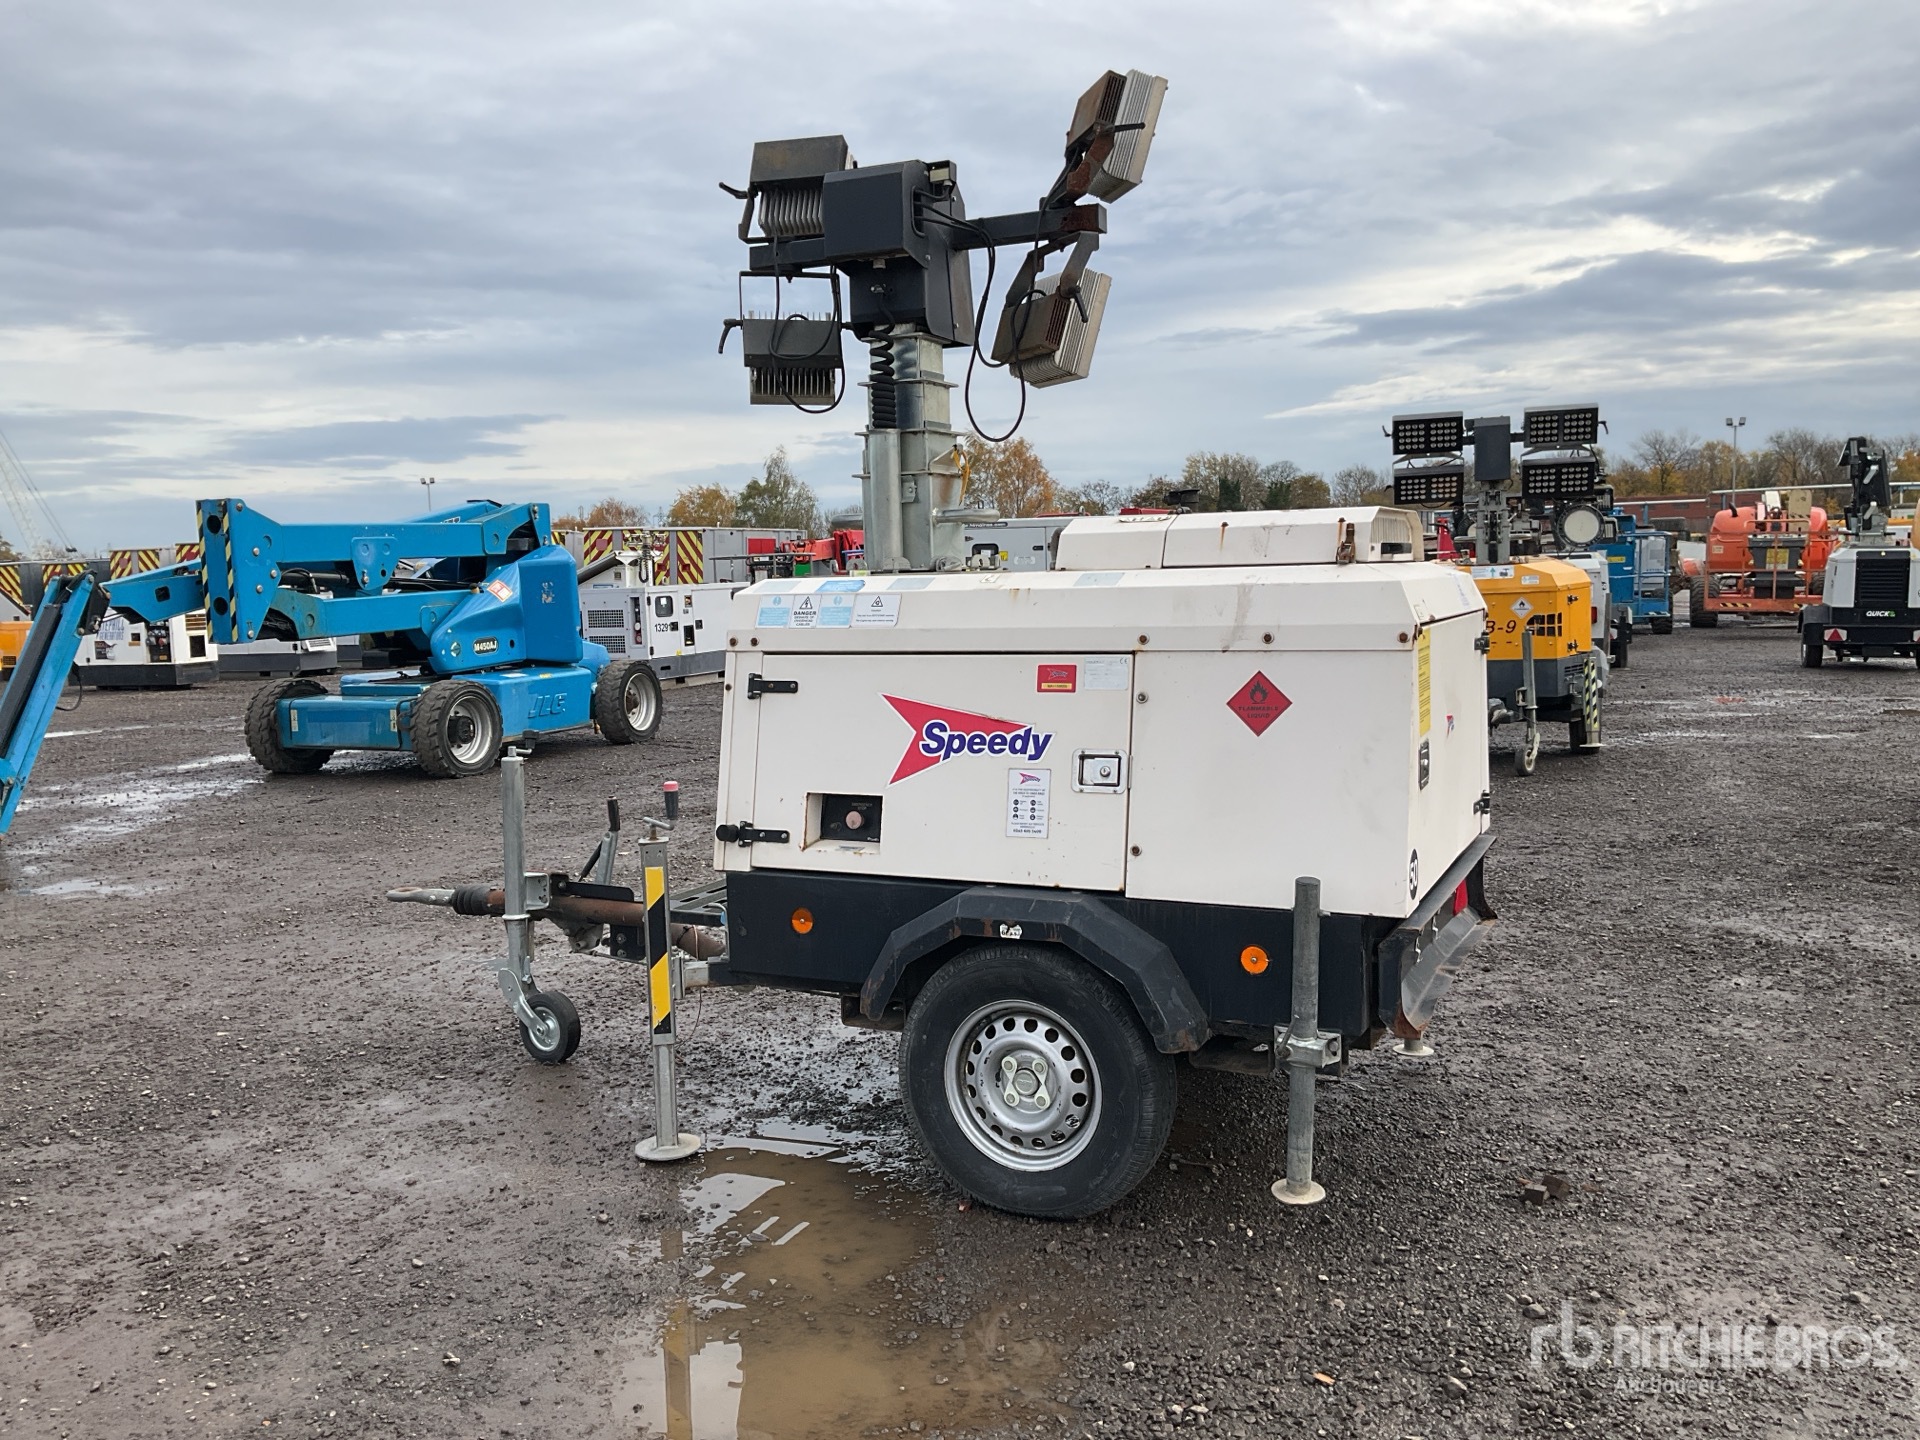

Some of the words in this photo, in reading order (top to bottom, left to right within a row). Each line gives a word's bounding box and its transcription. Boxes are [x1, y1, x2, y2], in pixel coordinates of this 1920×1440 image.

[474, 640, 497, 651] M450AJ
[528, 693, 568, 719] JLG
[921, 721, 1053, 761] Speedy
